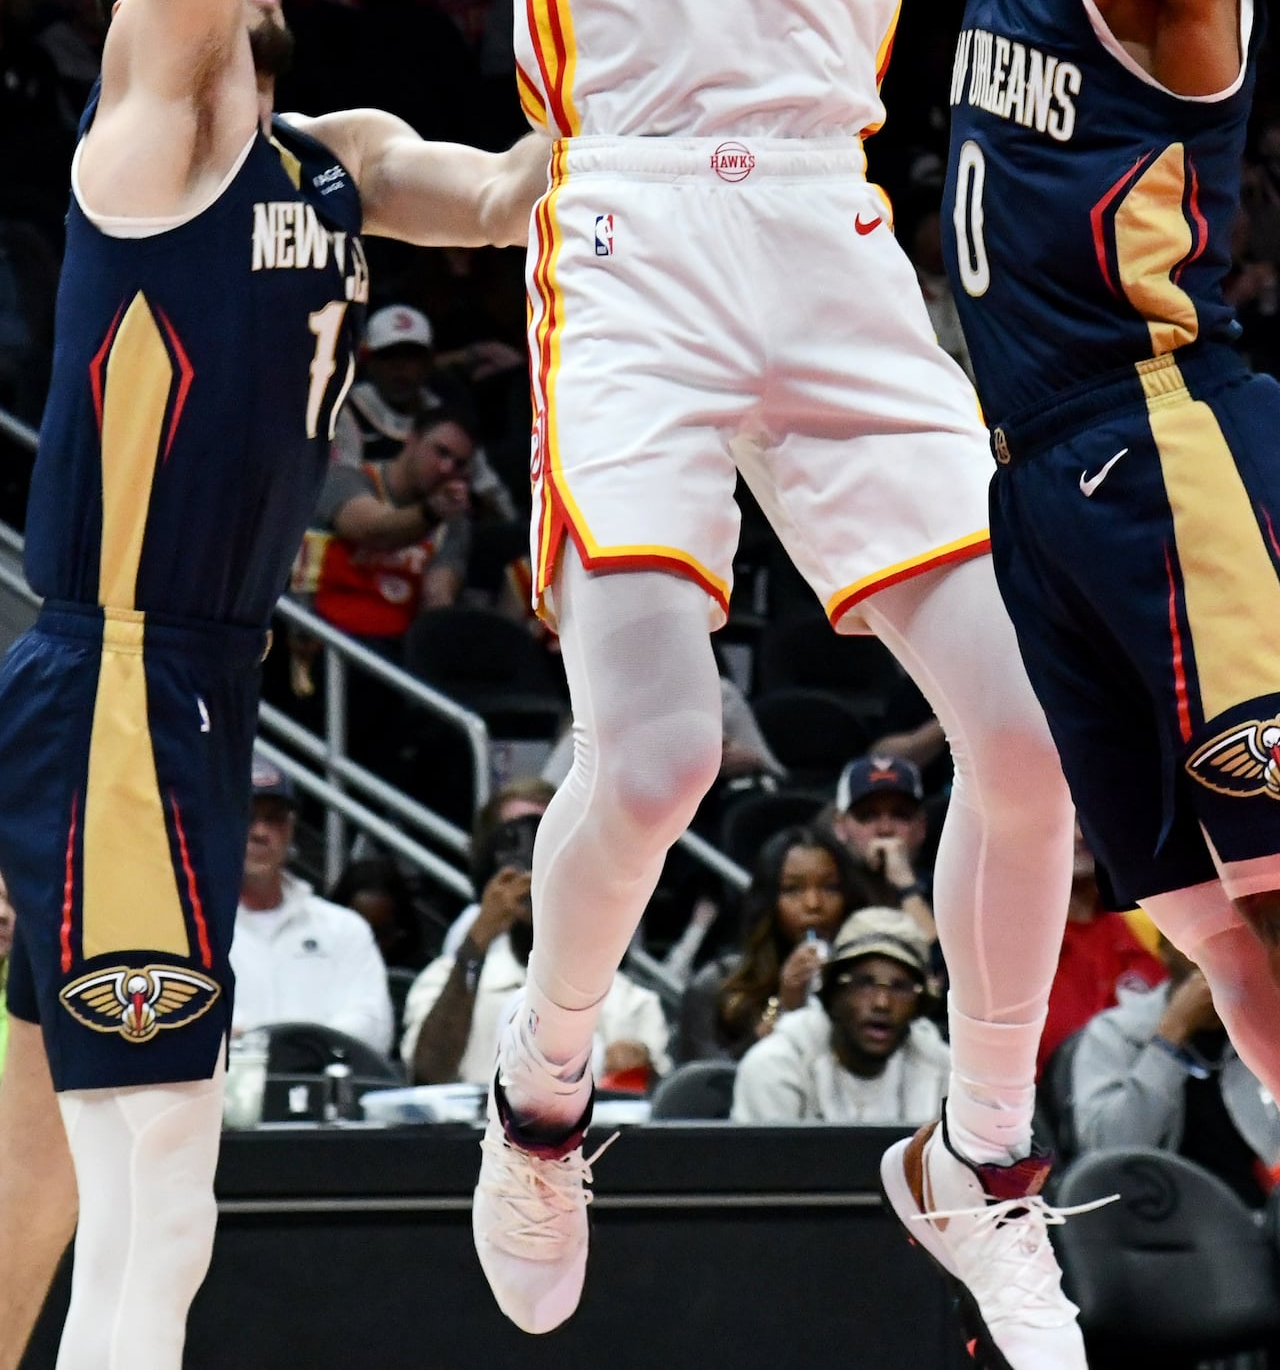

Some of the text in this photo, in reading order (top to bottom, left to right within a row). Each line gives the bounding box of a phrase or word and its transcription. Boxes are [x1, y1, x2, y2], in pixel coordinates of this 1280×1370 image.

[968, 28, 1082, 142] ORLEANS
[710, 155, 756, 169] HAWKS
[251, 202, 328, 271] NEW
[953, 139, 991, 298] 0
